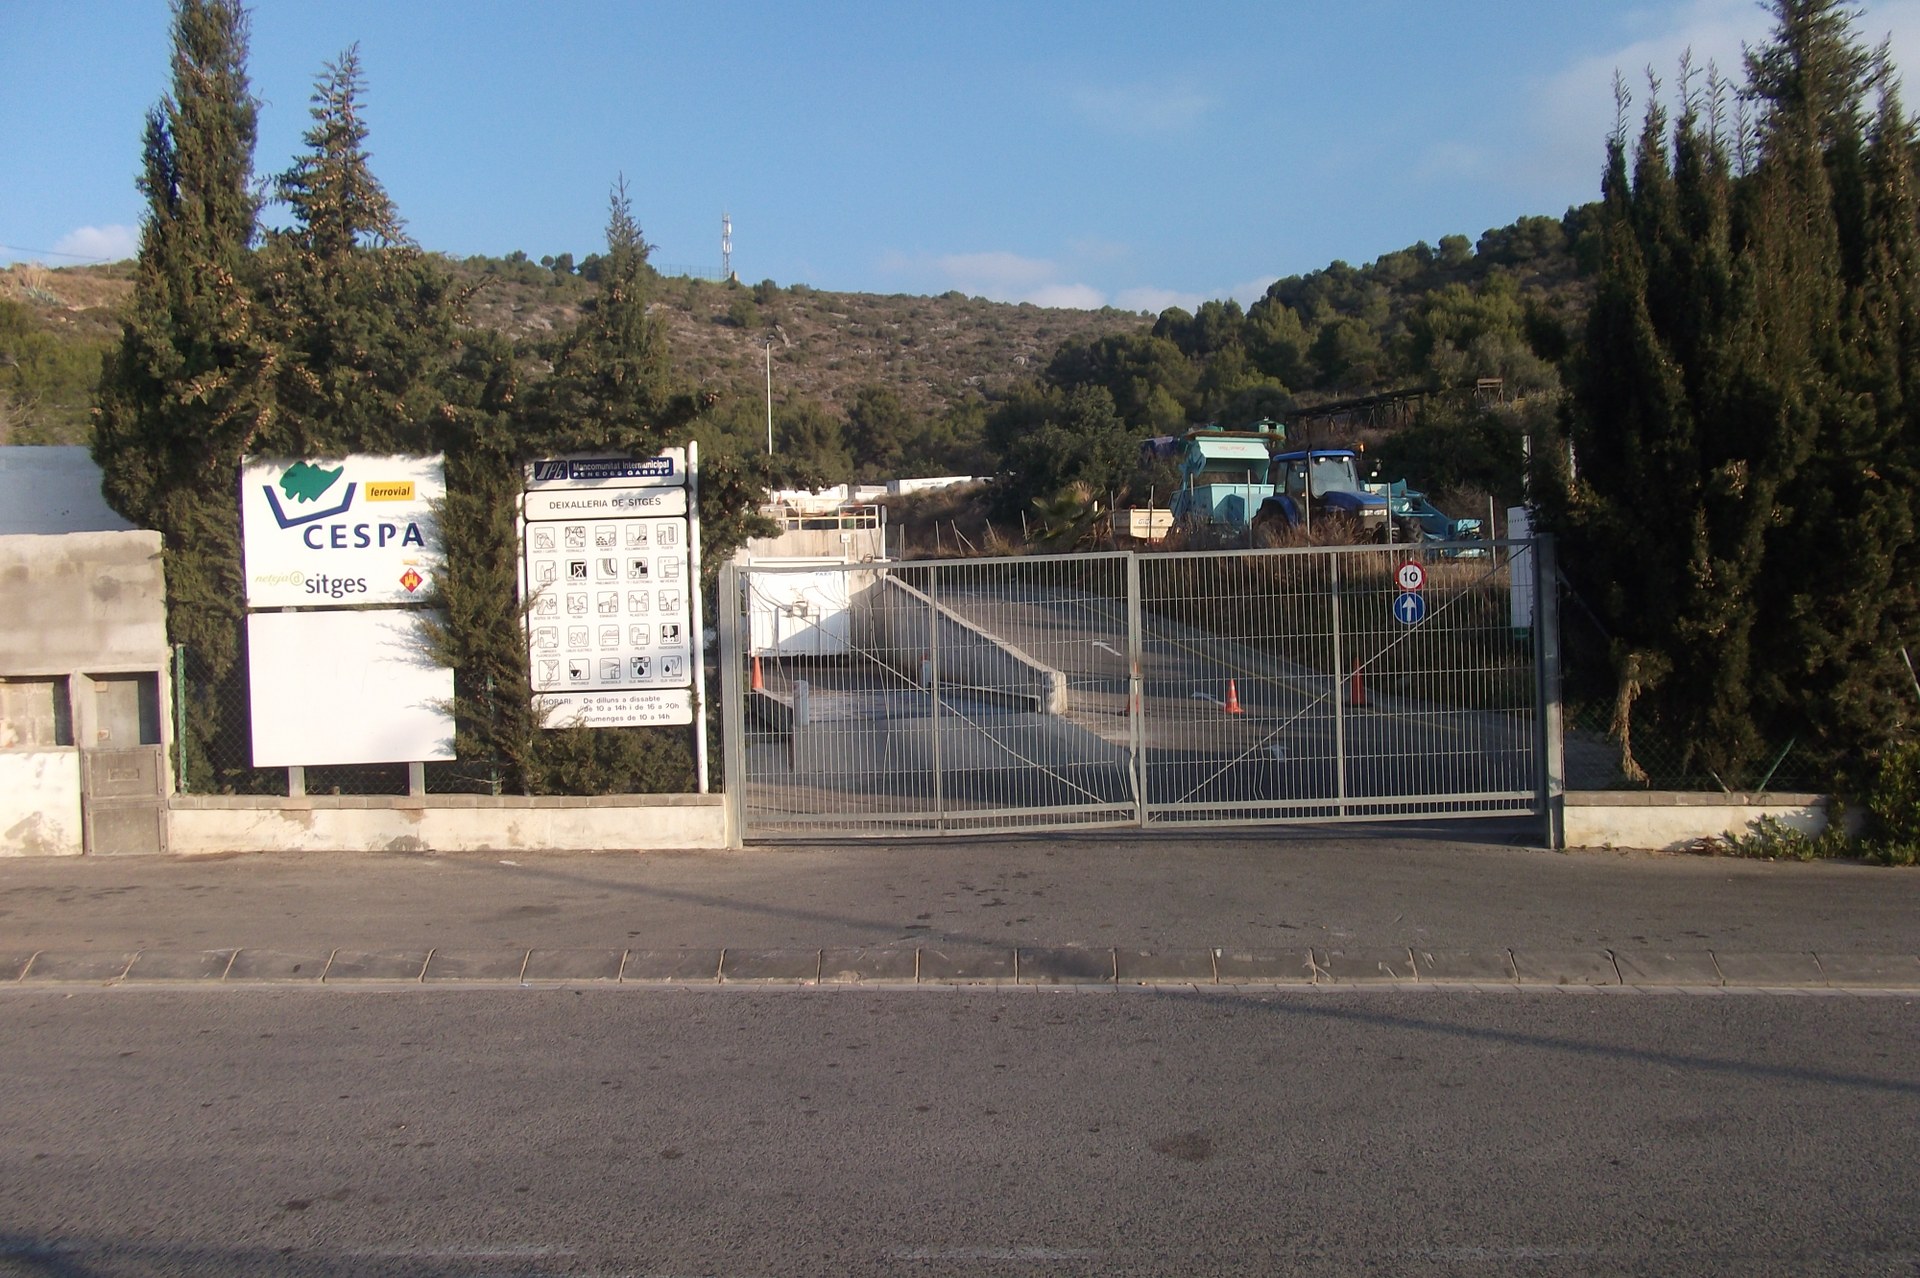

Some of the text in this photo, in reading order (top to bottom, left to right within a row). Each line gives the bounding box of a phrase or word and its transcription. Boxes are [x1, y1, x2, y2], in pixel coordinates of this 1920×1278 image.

[573, 463, 620, 471] Mancomunitat
[370, 487, 410, 497] ferrovial
[549, 501, 608, 510] DEIXALLERIA
[628, 498, 661, 506] SITGES
[303, 523, 424, 549] CESPA
[1403, 571, 1418, 582] 10
[305, 573, 367, 598] sitges
